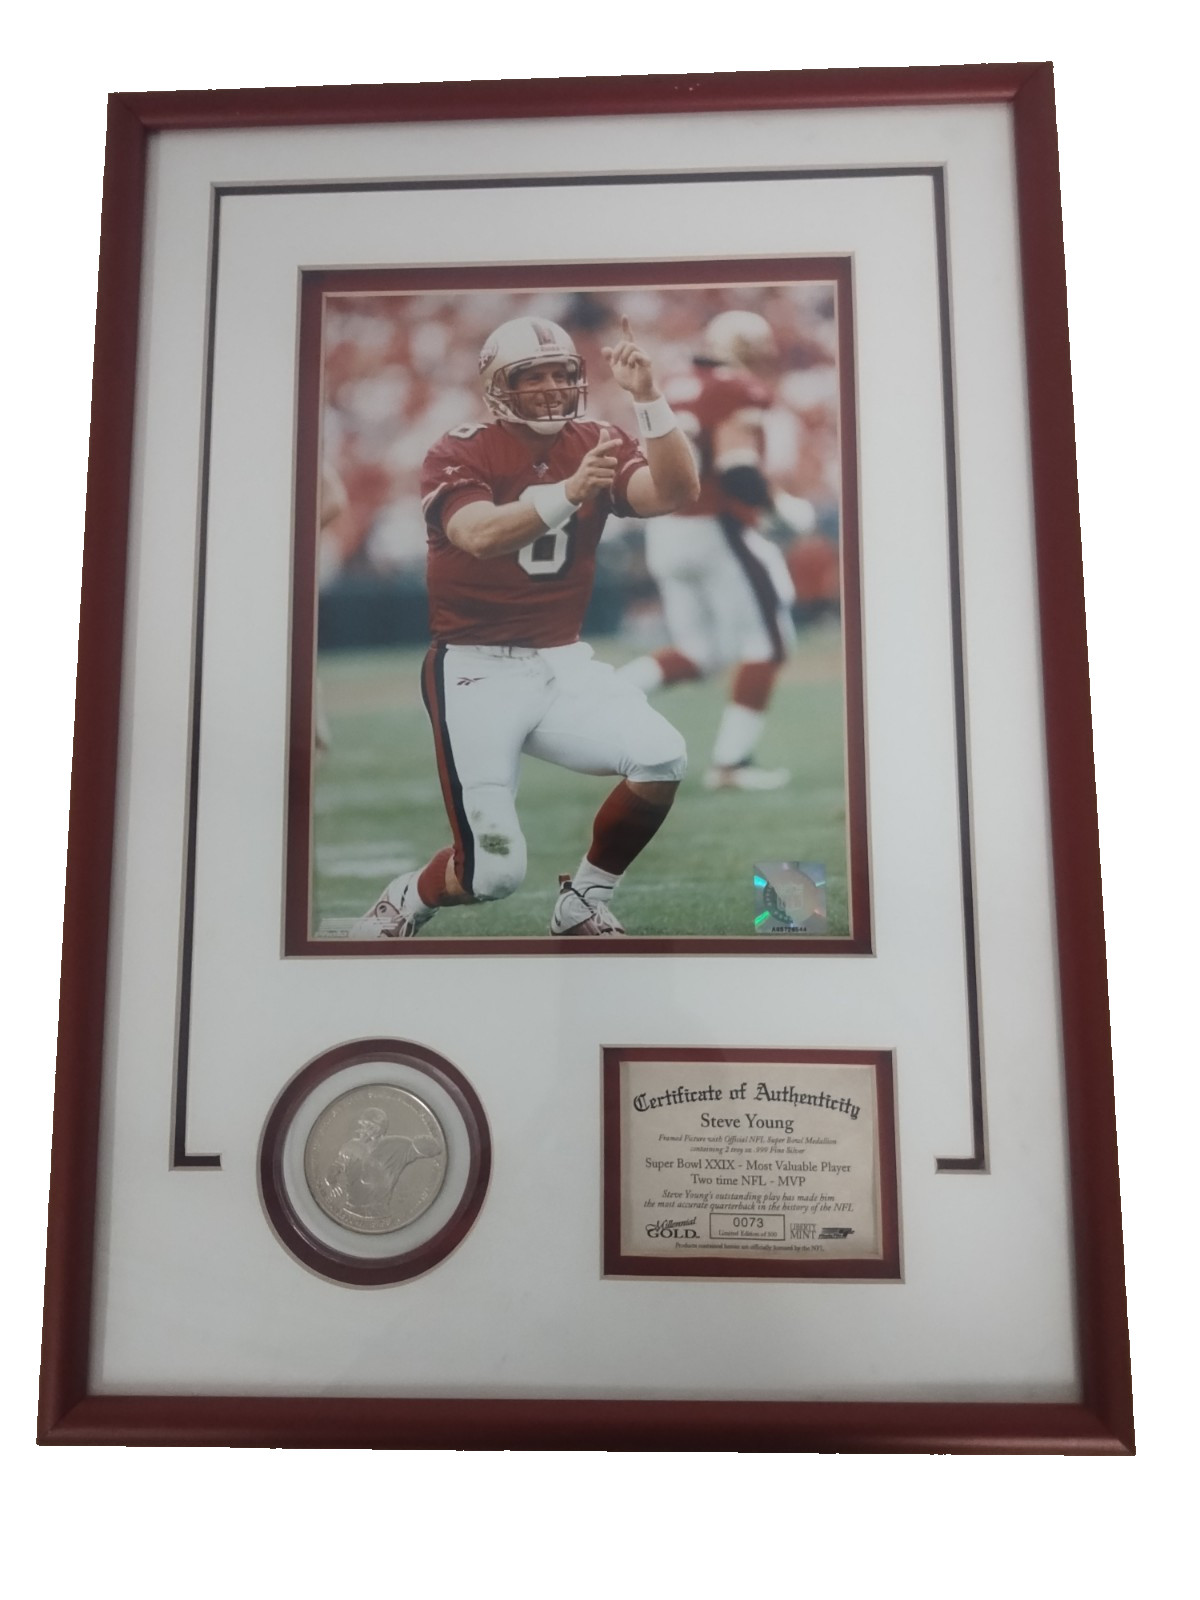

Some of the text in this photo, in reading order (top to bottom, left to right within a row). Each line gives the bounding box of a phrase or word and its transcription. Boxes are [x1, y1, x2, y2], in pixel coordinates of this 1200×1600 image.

[633, 1082, 860, 1120] Certificate of Authenticity
[701, 1112, 794, 1134] Steve Young
[659, 1133, 682, 1142] Framed
[684, 1134, 706, 1142] Picture
[707, 1135, 723, 1143] with
[724, 1135, 748, 1145] Official
[767, 1136, 785, 1146] Super
[786, 1136, 803, 1144] Bowl
[805, 1136, 837, 1145] Medallion
[690, 1146, 723, 1155] containing
[731, 1147, 743, 1155] troy
[645, 1157, 674, 1172] Super
[677, 1158, 702, 1169] Bowl
[705, 1159, 735, 1170] XXIX
[746, 1160, 772, 1171] Most
[775, 1161, 818, 1172] Valuable
[821, 1162, 851, 1175] Player
[690, 1173, 713, 1184] Two
[716, 1175, 738, 1185] time
[741, 1175, 767, 1186] NFL
[778, 1176, 806, 1186] MVP
[662, 1189, 835, 1204] Steve Young's outstanding play has made him
[644, 1199, 656, 1208] the
[677, 1201, 708, 1209] accurate
[709, 1202, 755, 1212] quarterback
[757, 1203, 766, 1211] in
[768, 1202, 780, 1211] the
[782, 1202, 808, 1214] history
[810, 1203, 820, 1214] of
[820, 1203, 832, 1211] the
[645, 1216, 697, 1231] Millennial
[733, 1217, 764, 1228] 0073
[790, 1223, 816, 1232] LIBERTY
[790, 1231, 816, 1239] MINT
